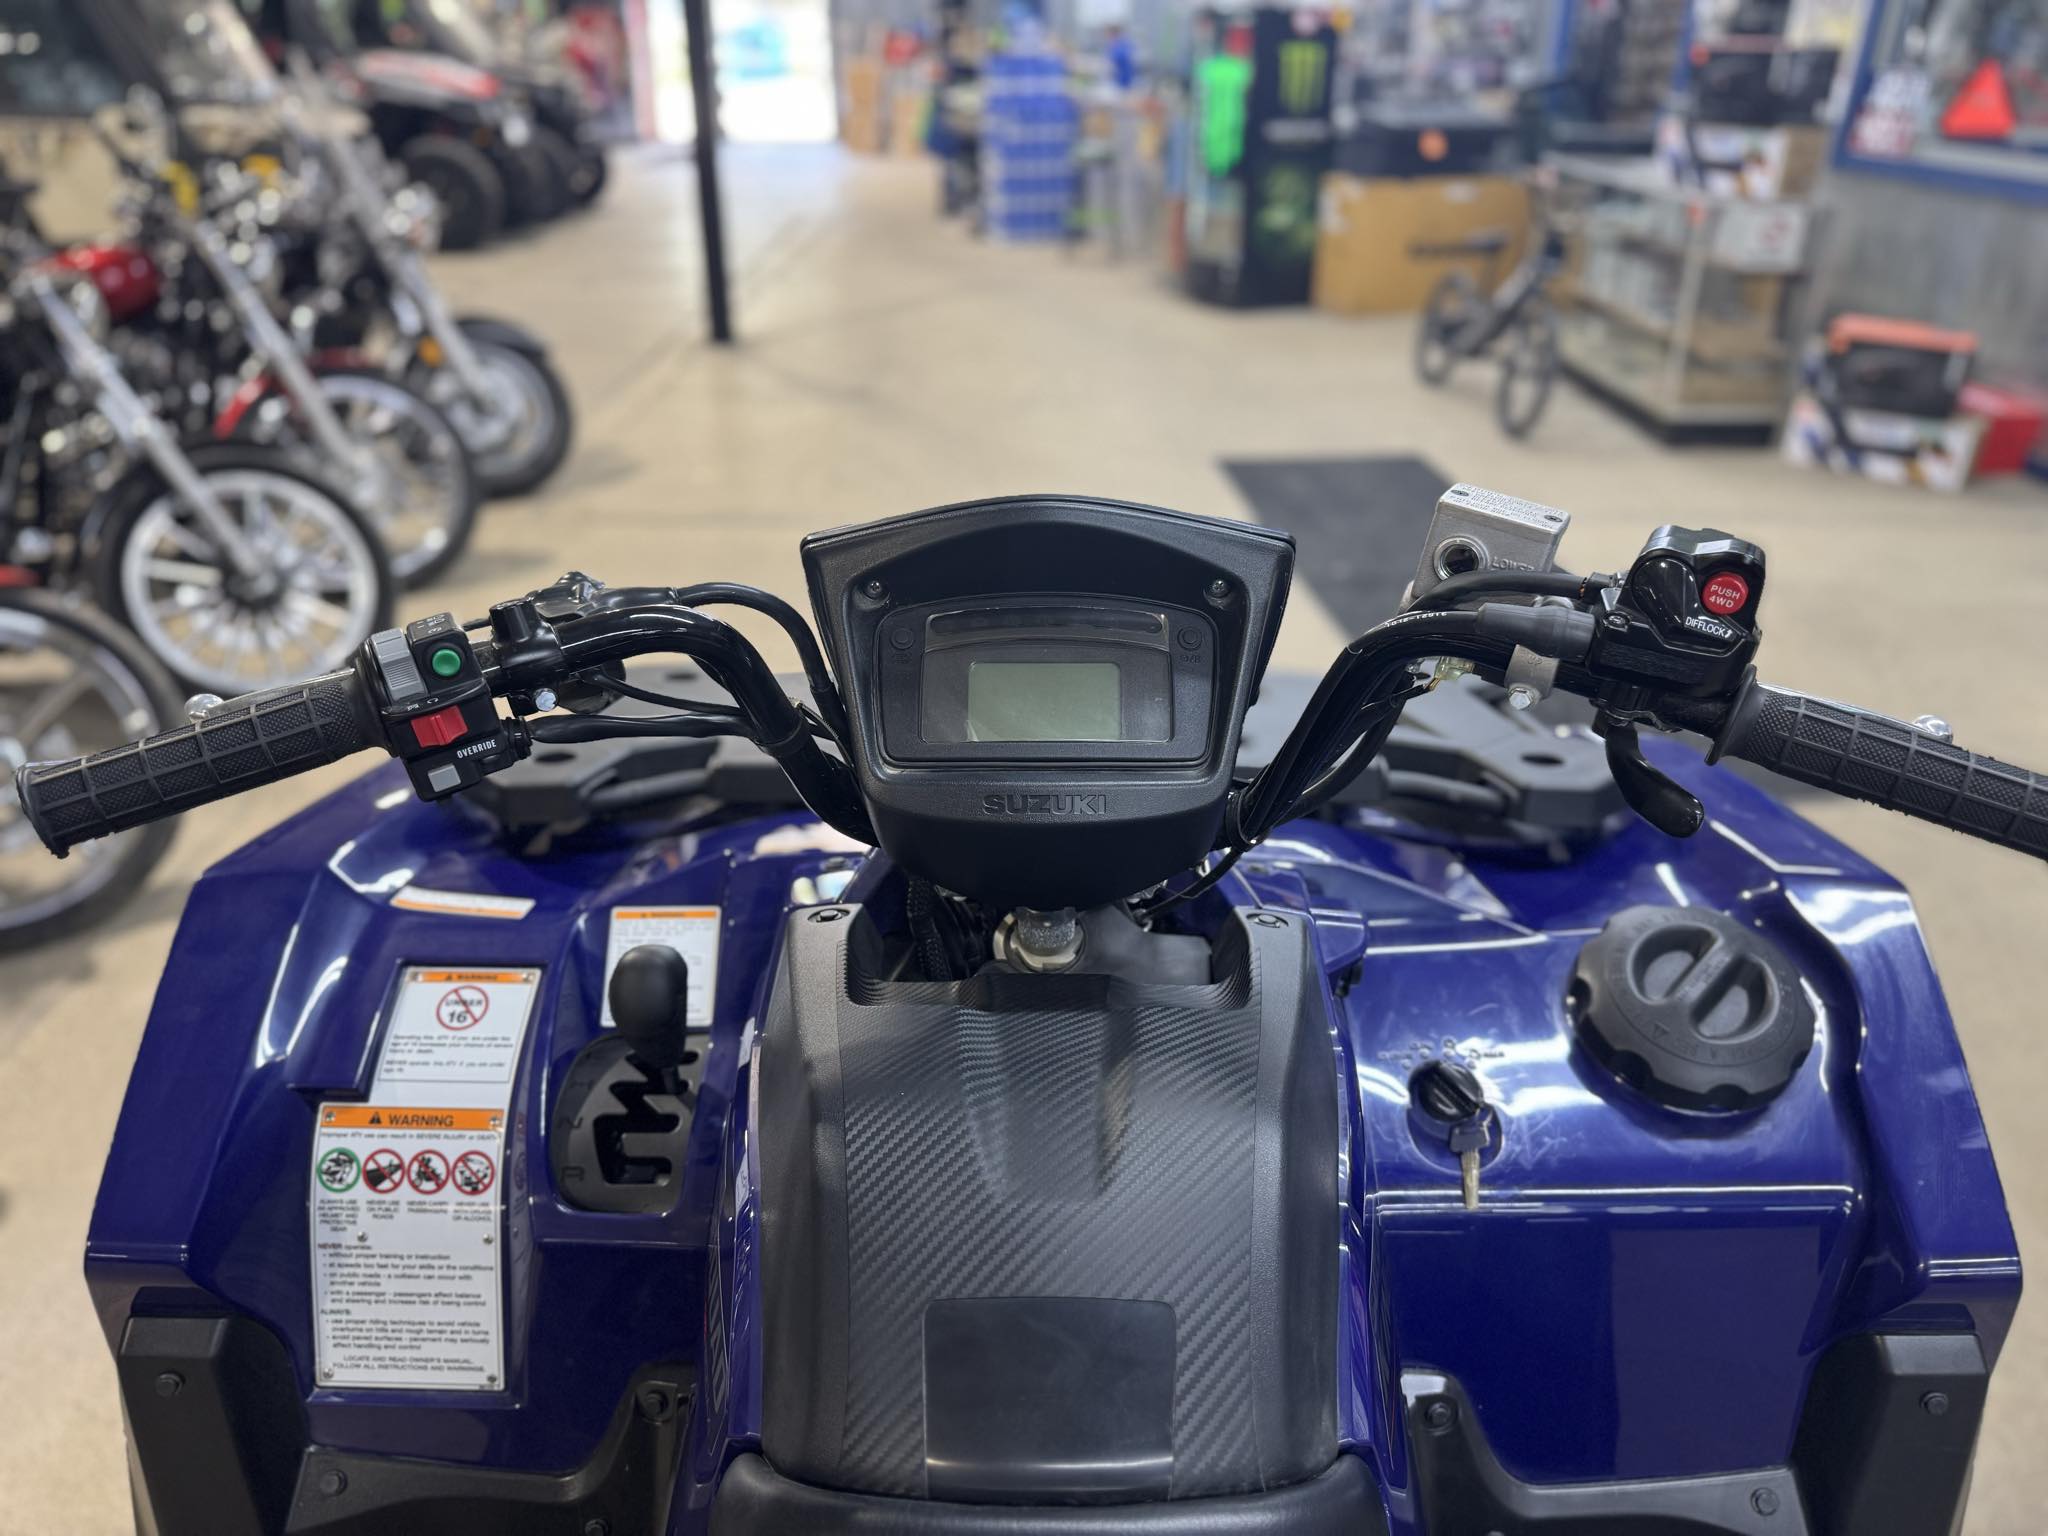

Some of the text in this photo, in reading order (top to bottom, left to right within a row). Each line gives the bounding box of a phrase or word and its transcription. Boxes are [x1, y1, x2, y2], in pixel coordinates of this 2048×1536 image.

[1710, 584, 1740, 600] PUSH
[1709, 595, 1734, 608] 4WD
[1685, 616, 1726, 637] DIFFLOCK
[456, 739, 497, 759] OVERRIDE
[982, 794, 1107, 815] SUZUKI
[449, 1010, 467, 1023] 16
[389, 1114, 454, 1127] WARNING
